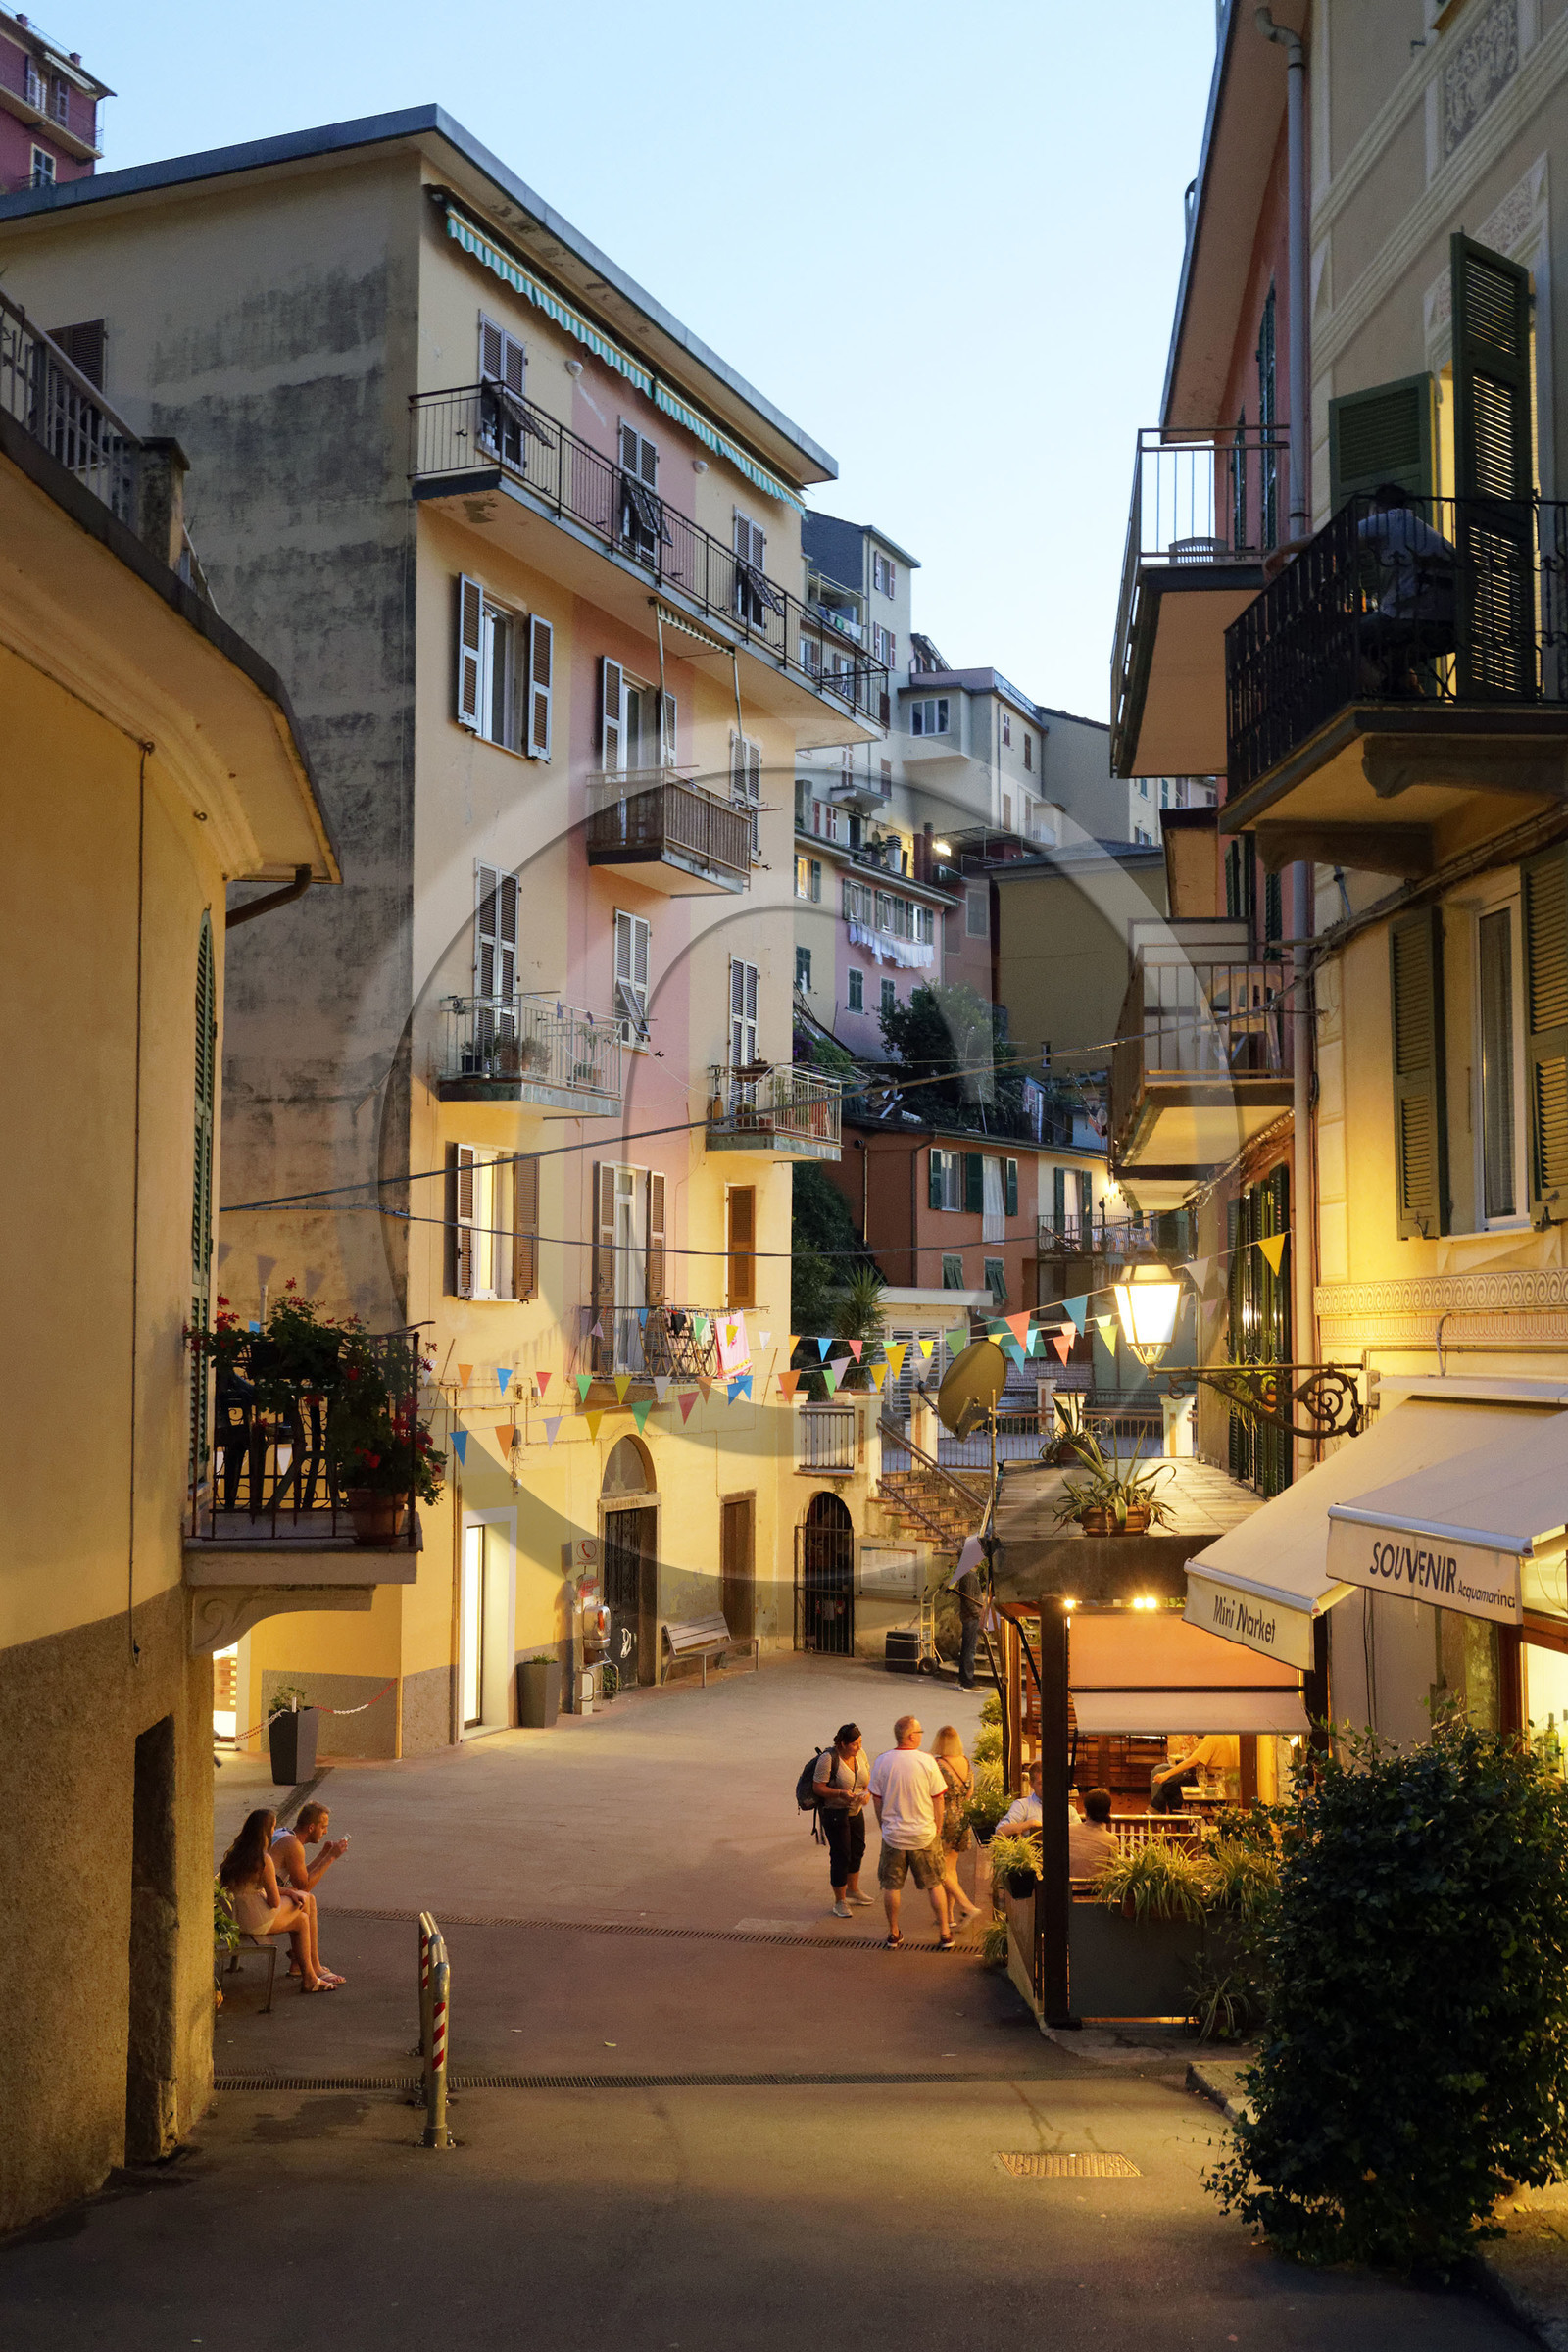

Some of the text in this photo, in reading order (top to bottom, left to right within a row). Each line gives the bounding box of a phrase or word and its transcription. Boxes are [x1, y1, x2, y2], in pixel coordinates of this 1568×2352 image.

[1369, 1541, 1516, 1609] SOUVENIR Acquamarina
[1212, 1594, 1276, 1644] Mini Market
